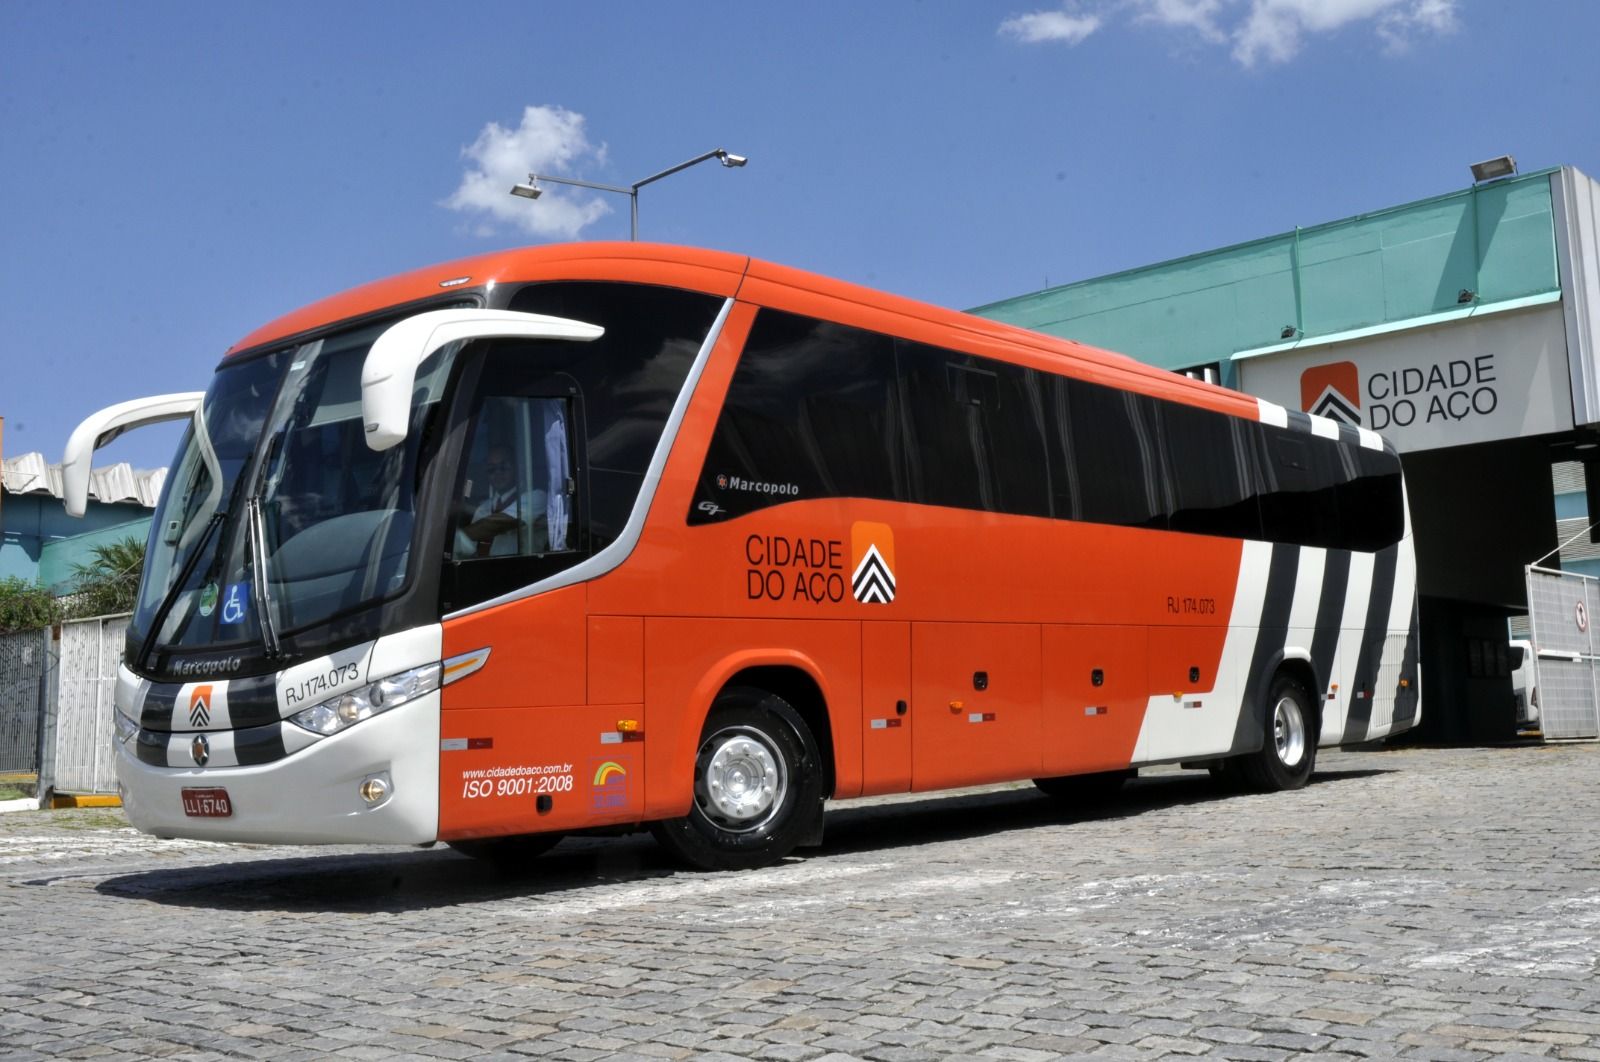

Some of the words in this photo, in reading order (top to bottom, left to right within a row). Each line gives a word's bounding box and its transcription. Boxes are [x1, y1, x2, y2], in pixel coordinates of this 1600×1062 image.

[1368, 354, 1496, 400] CIDADE
[1369, 399, 1416, 431] DO
[1426, 386, 1498, 422] AÇO
[729, 476, 799, 495] Marcopolo
[746, 534, 843, 570] CIDADE
[747, 569, 785, 601] DO
[793, 571, 845, 604] AÇO
[1167, 596, 1180, 614] RJ
[1183, 598, 1215, 615] 174.073
[173, 657, 241, 675] Marcopolo
[462, 762, 573, 779] www.cidadedoaco.com.br
[463, 779, 493, 798] ISO
[497, 775, 573, 796] 9001:2008
